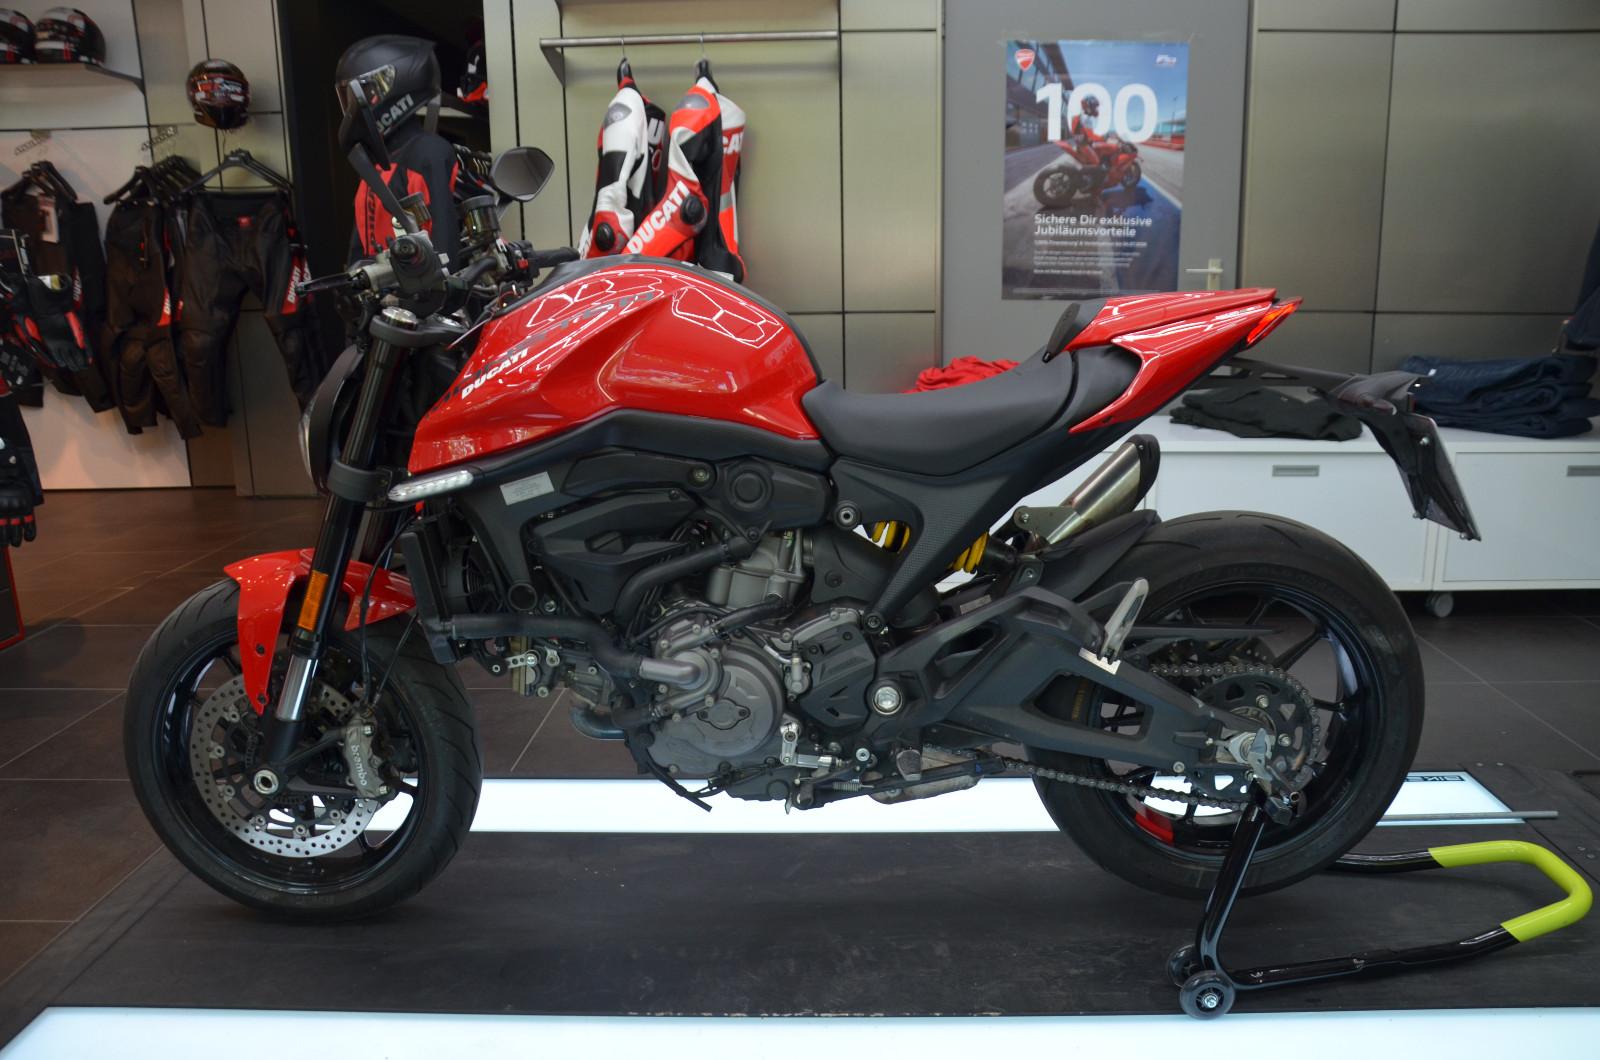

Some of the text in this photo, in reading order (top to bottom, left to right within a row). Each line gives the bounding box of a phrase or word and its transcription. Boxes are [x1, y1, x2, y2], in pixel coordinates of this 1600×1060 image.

[376, 93, 415, 133] UCATI
[1035, 82, 1158, 144] 100
[627, 181, 690, 254] DUCATI
[1034, 213, 1153, 227] Sichere Dir exklusive
[1034, 225, 1137, 237] Jubiläumsvorteile
[461, 348, 529, 400] DUCATI
[351, 745, 367, 786] brembo
